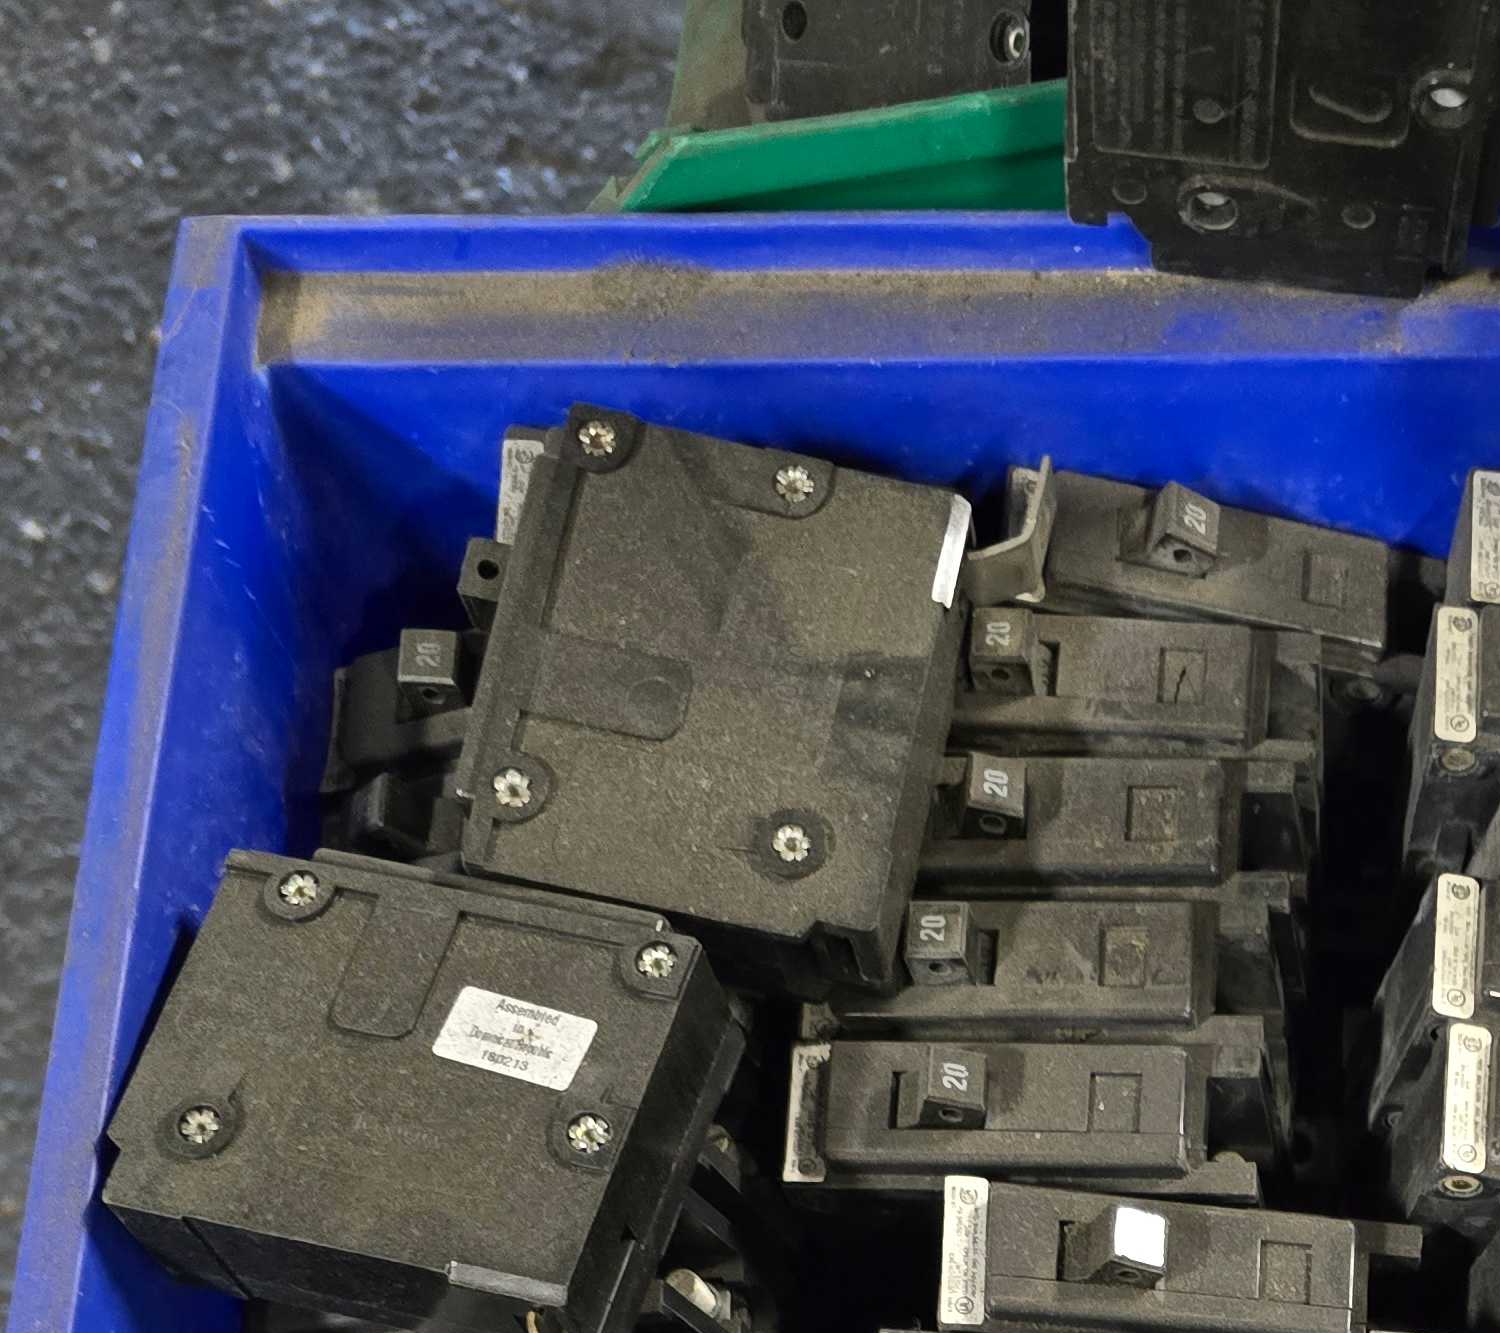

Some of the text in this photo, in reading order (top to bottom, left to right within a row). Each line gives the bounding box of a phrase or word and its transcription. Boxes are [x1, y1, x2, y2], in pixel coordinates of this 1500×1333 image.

[1183, 504, 1208, 534] 20
[986, 621, 1011, 647] 20
[983, 769, 1008, 798] 20
[921, 914, 946, 942] 20
[942, 1062, 968, 1091] 20
